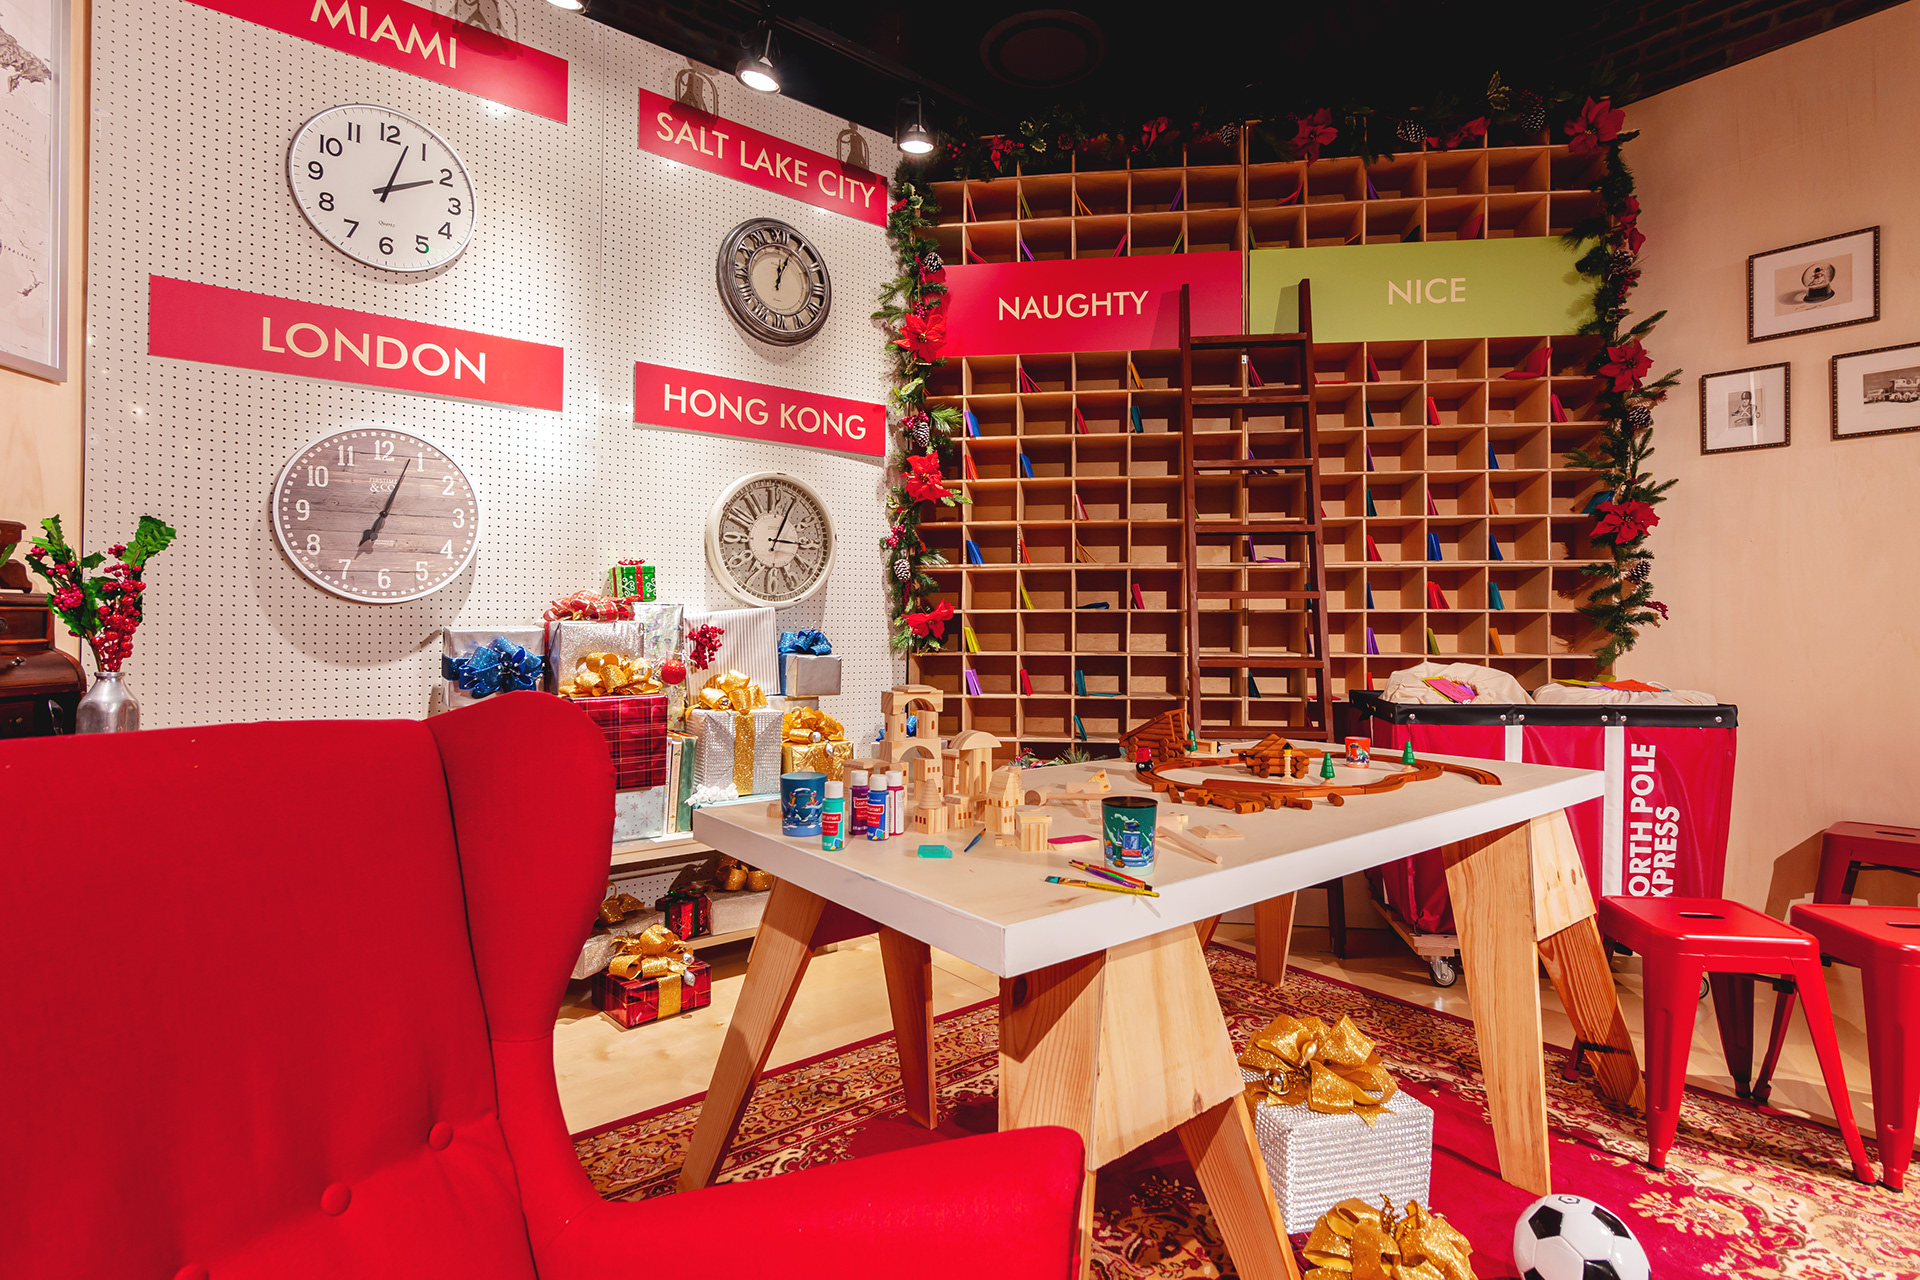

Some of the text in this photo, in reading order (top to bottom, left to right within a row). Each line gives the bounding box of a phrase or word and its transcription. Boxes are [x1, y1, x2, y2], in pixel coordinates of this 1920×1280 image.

[310, 0, 457, 69] MIAMI
[347, 121, 362, 144] 11
[380, 122, 401, 146] 12
[319, 134, 343, 157] 10
[421, 143, 427, 162] 1
[308, 160, 324, 180] 9
[656, 112, 876, 208] SALT LAKE CITY
[439, 168, 454, 188] 2
[318, 191, 335, 212] 8
[447, 197, 462, 216] 3
[343, 218, 360, 238] 7
[437, 221, 453, 240] 4
[379, 236, 394, 255] 6
[415, 234, 430, 254] 5
[1388, 277, 1466, 305] NICE
[998, 290, 1149, 321] NAUGHTY
[262, 316, 486, 384] LONDON
[664, 383, 866, 440] HONG KONG
[337, 445, 356, 467] 11
[374, 439, 395, 462] 12
[417, 451, 424, 472] 1
[306, 465, 329, 488] 10
[442, 475, 455, 496] 2
[295, 499, 310, 521] 9
[452, 508, 465, 529] 3
[306, 533, 321, 556] 8
[440, 539, 454, 559] 4
[338, 559, 352, 580] 7
[728, 549, 754, 568] 8
[377, 568, 392, 590] 6
[415, 561, 429, 581] 5
[767, 567, 778, 594] 6
[1628, 743, 1656, 897] ORTH POLE
[1651, 806, 1680, 898] XPRESS
